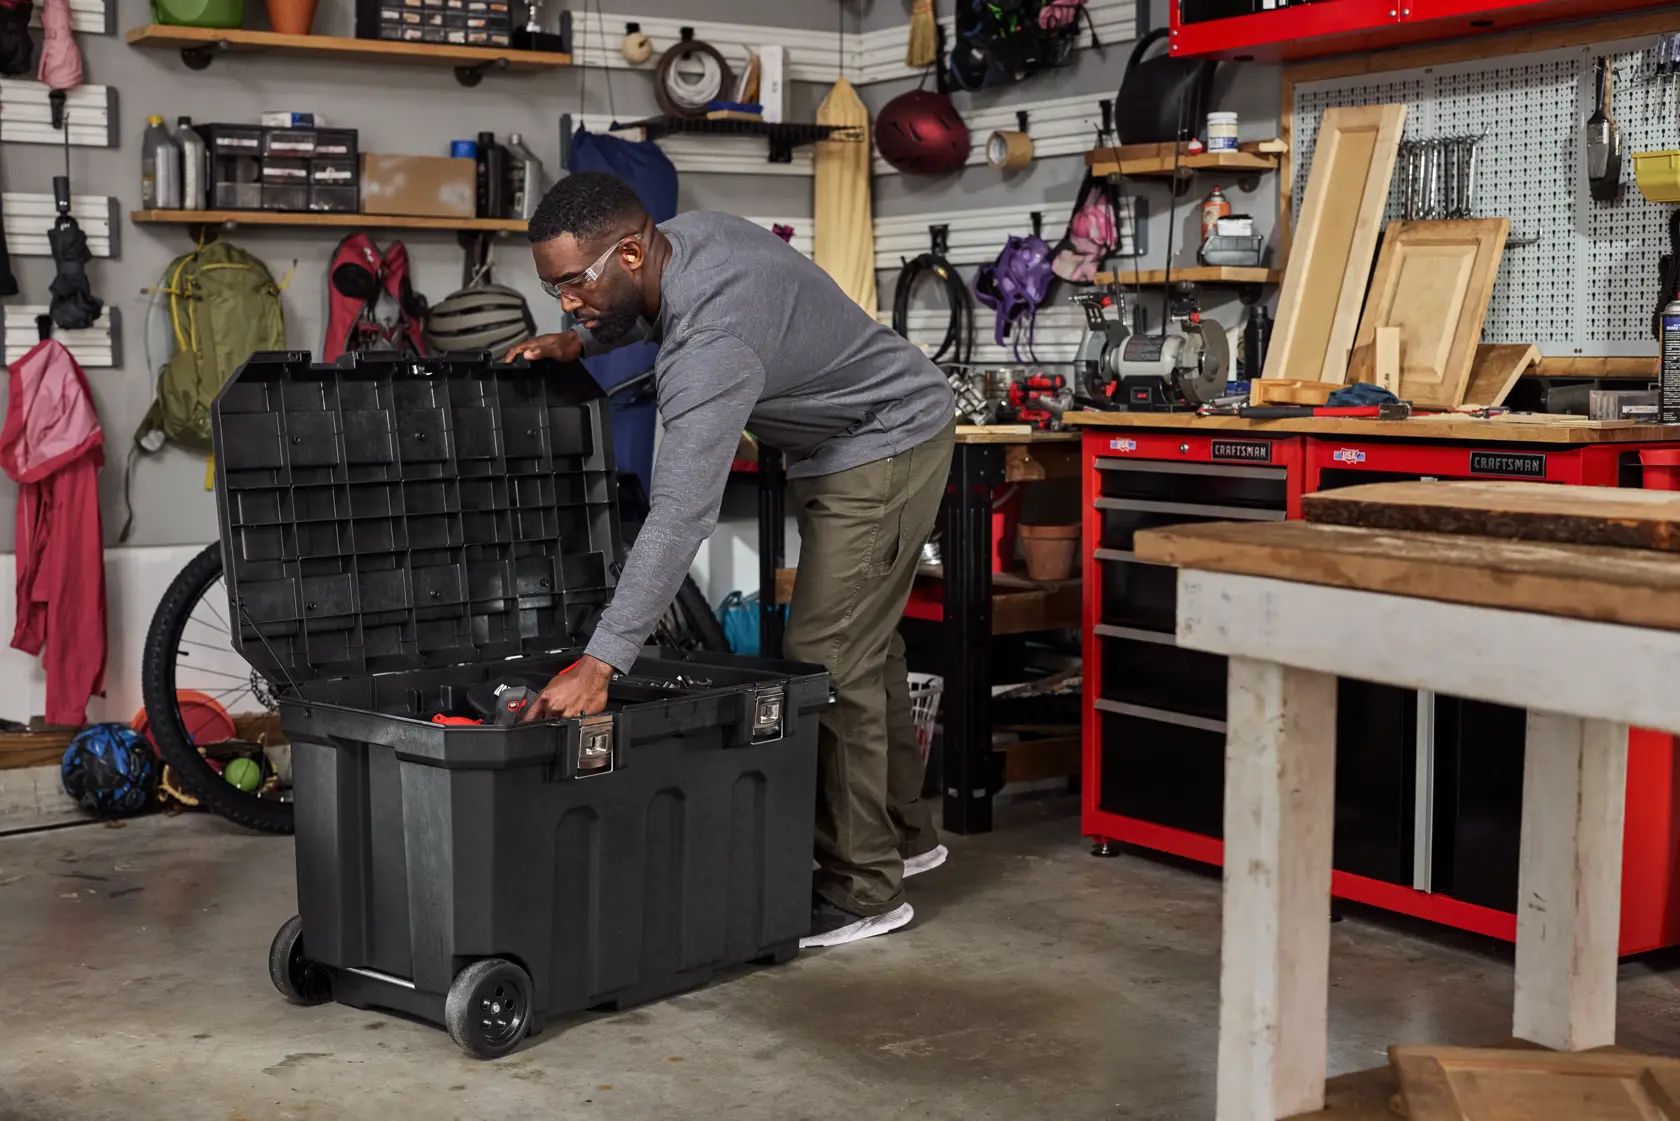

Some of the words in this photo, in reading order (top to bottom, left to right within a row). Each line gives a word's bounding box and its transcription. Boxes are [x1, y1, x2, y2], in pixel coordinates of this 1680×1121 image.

[1214, 444, 1267, 458] CRAFTSMAN
[1342, 450, 1356, 460] USA
[1473, 456, 1540, 472] CRAFTSMAN
